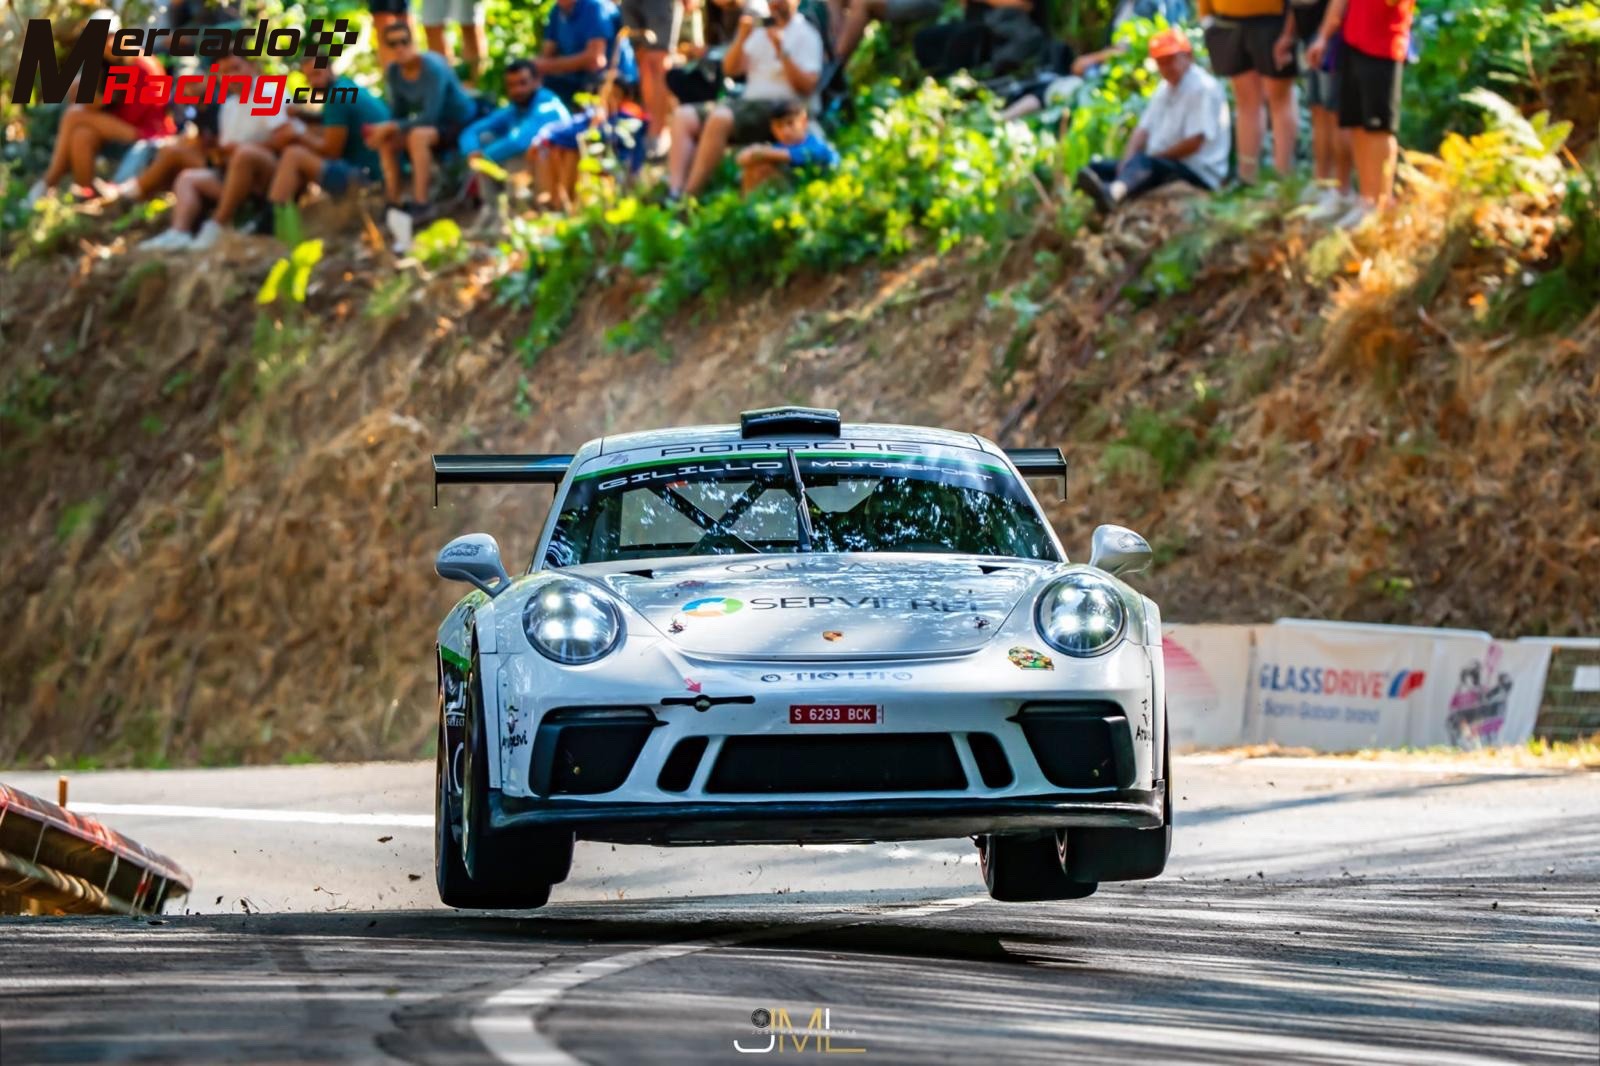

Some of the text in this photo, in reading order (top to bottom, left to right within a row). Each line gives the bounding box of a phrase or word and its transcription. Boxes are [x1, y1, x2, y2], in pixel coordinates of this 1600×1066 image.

[661, 442, 922, 457] PORSCHE
[598, 460, 993, 491] GILILLO MOTORSPORT
[794, 708, 871, 721] S 6293 BCK
